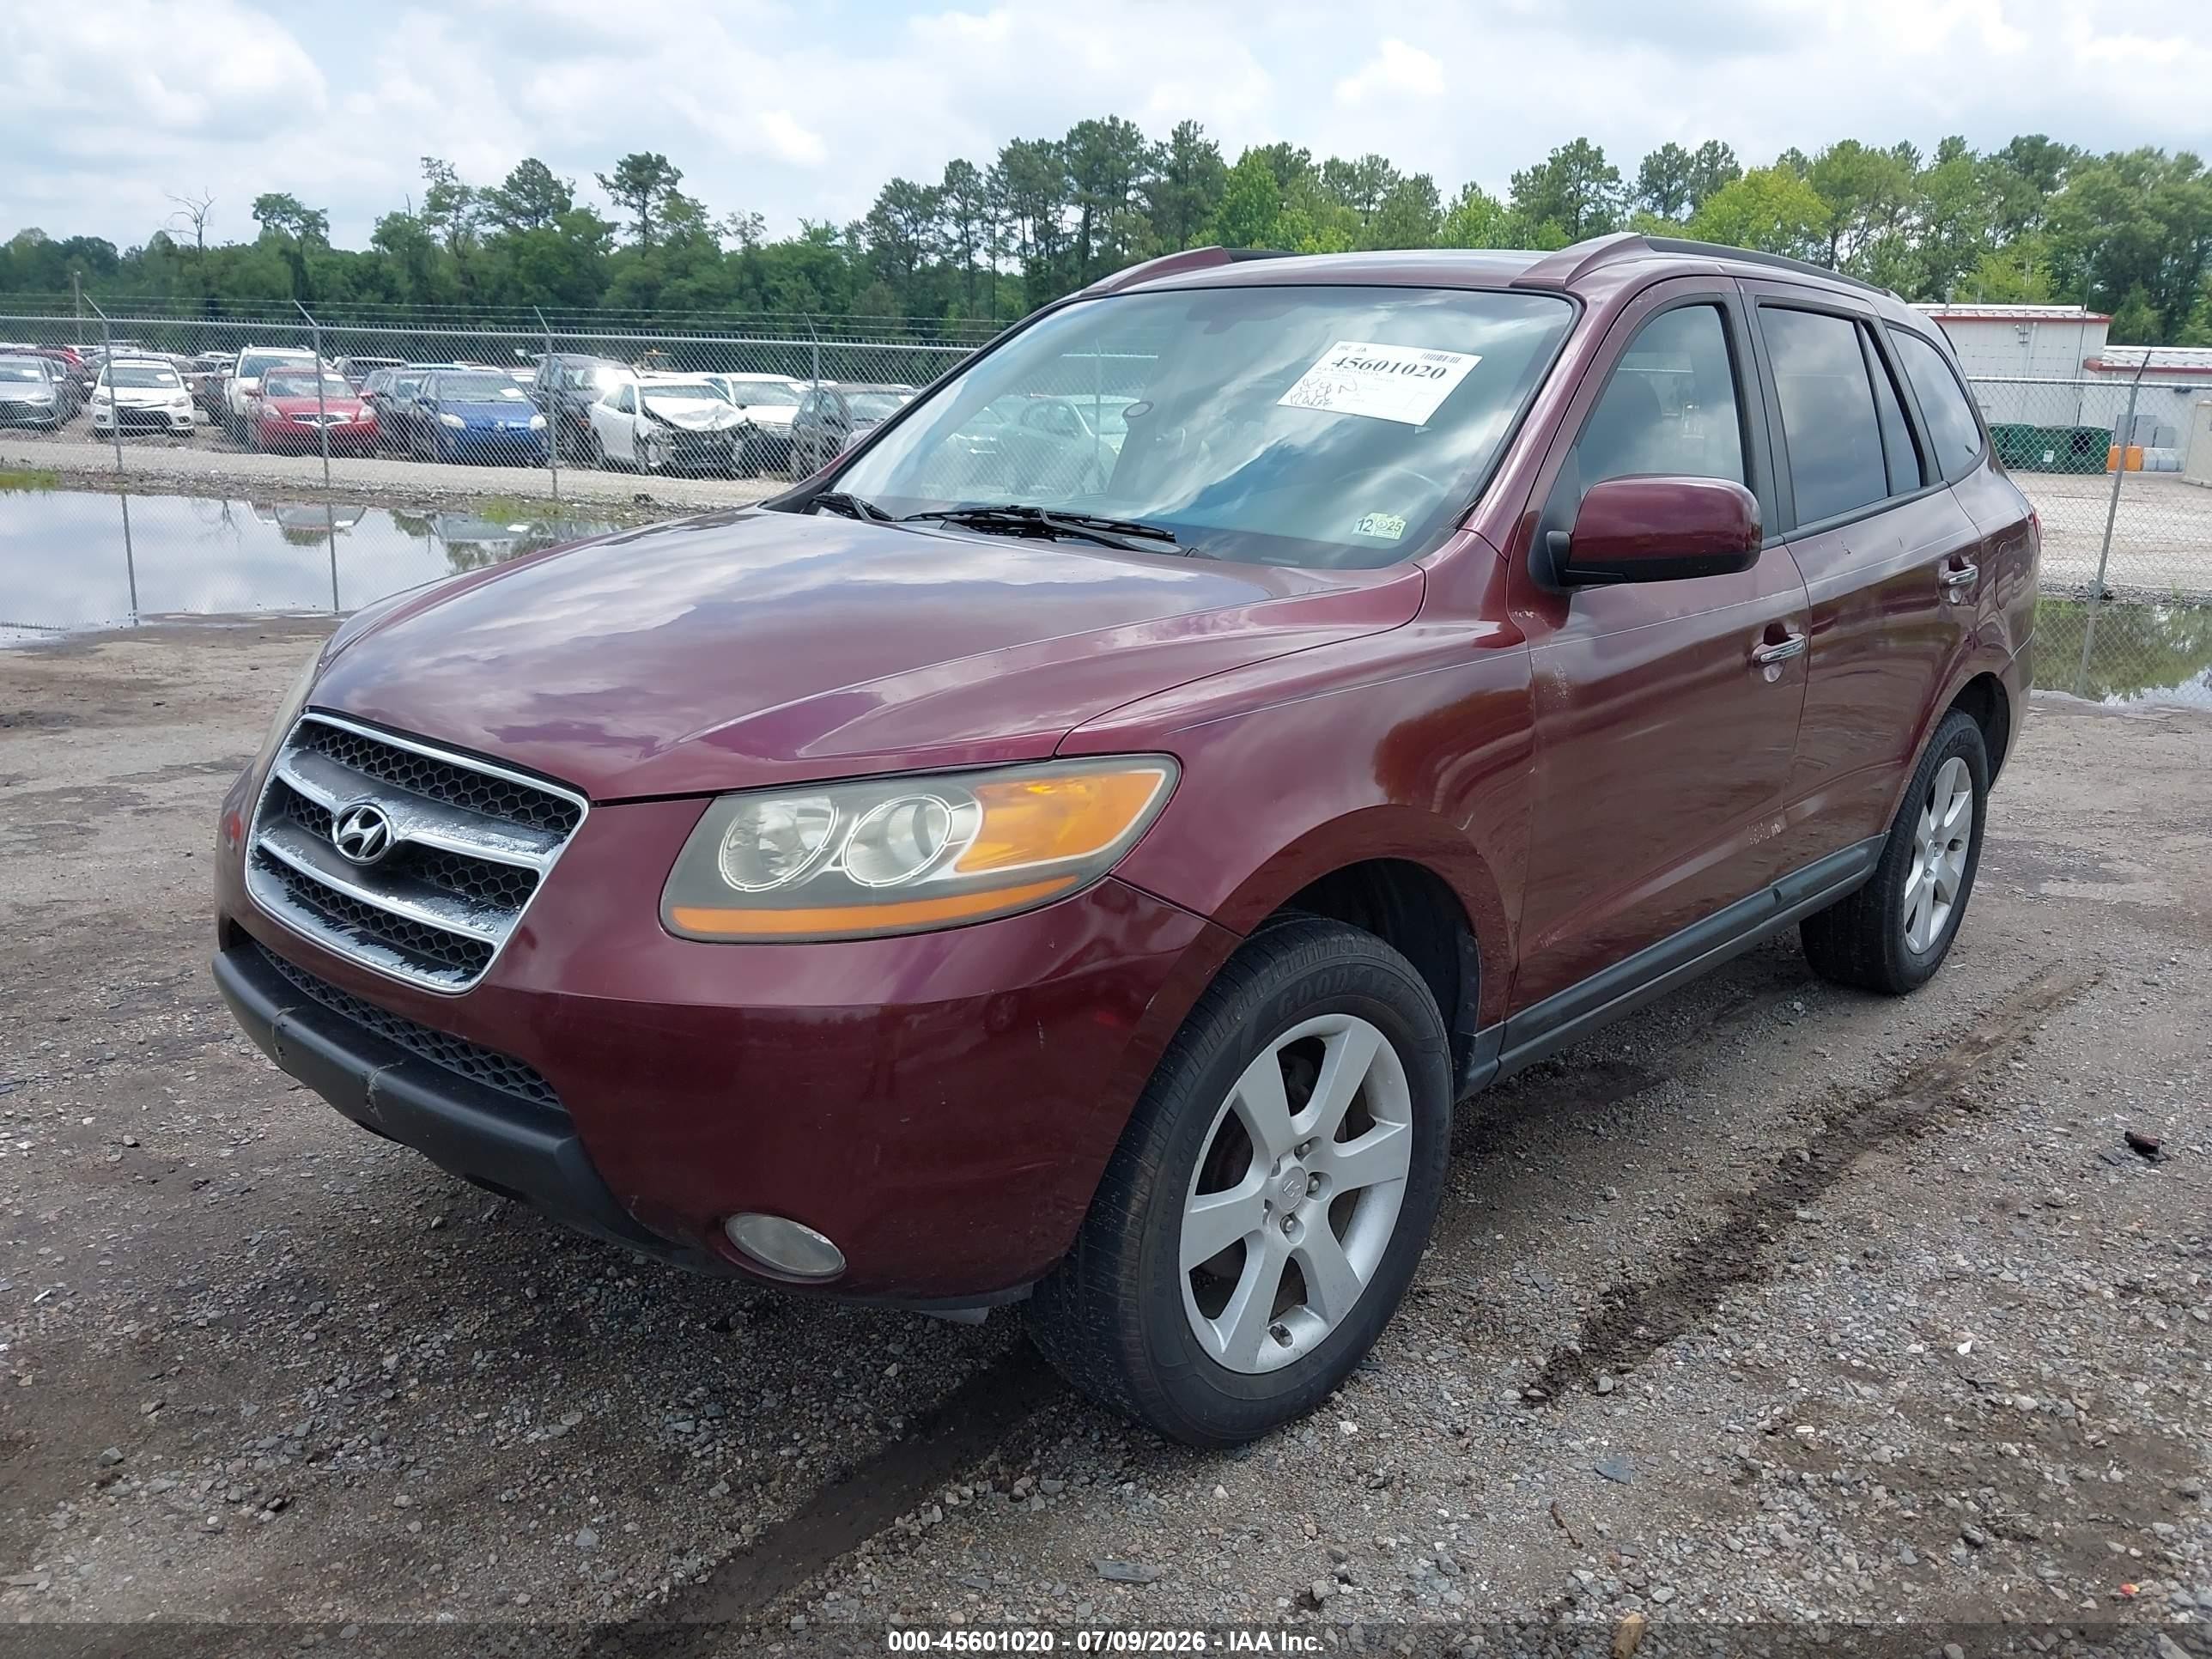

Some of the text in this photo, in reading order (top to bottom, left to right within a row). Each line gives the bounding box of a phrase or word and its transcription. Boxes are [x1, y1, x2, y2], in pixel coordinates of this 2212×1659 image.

[1331, 356, 1447, 380] 45601020
[1358, 519, 1402, 532] 12 25
